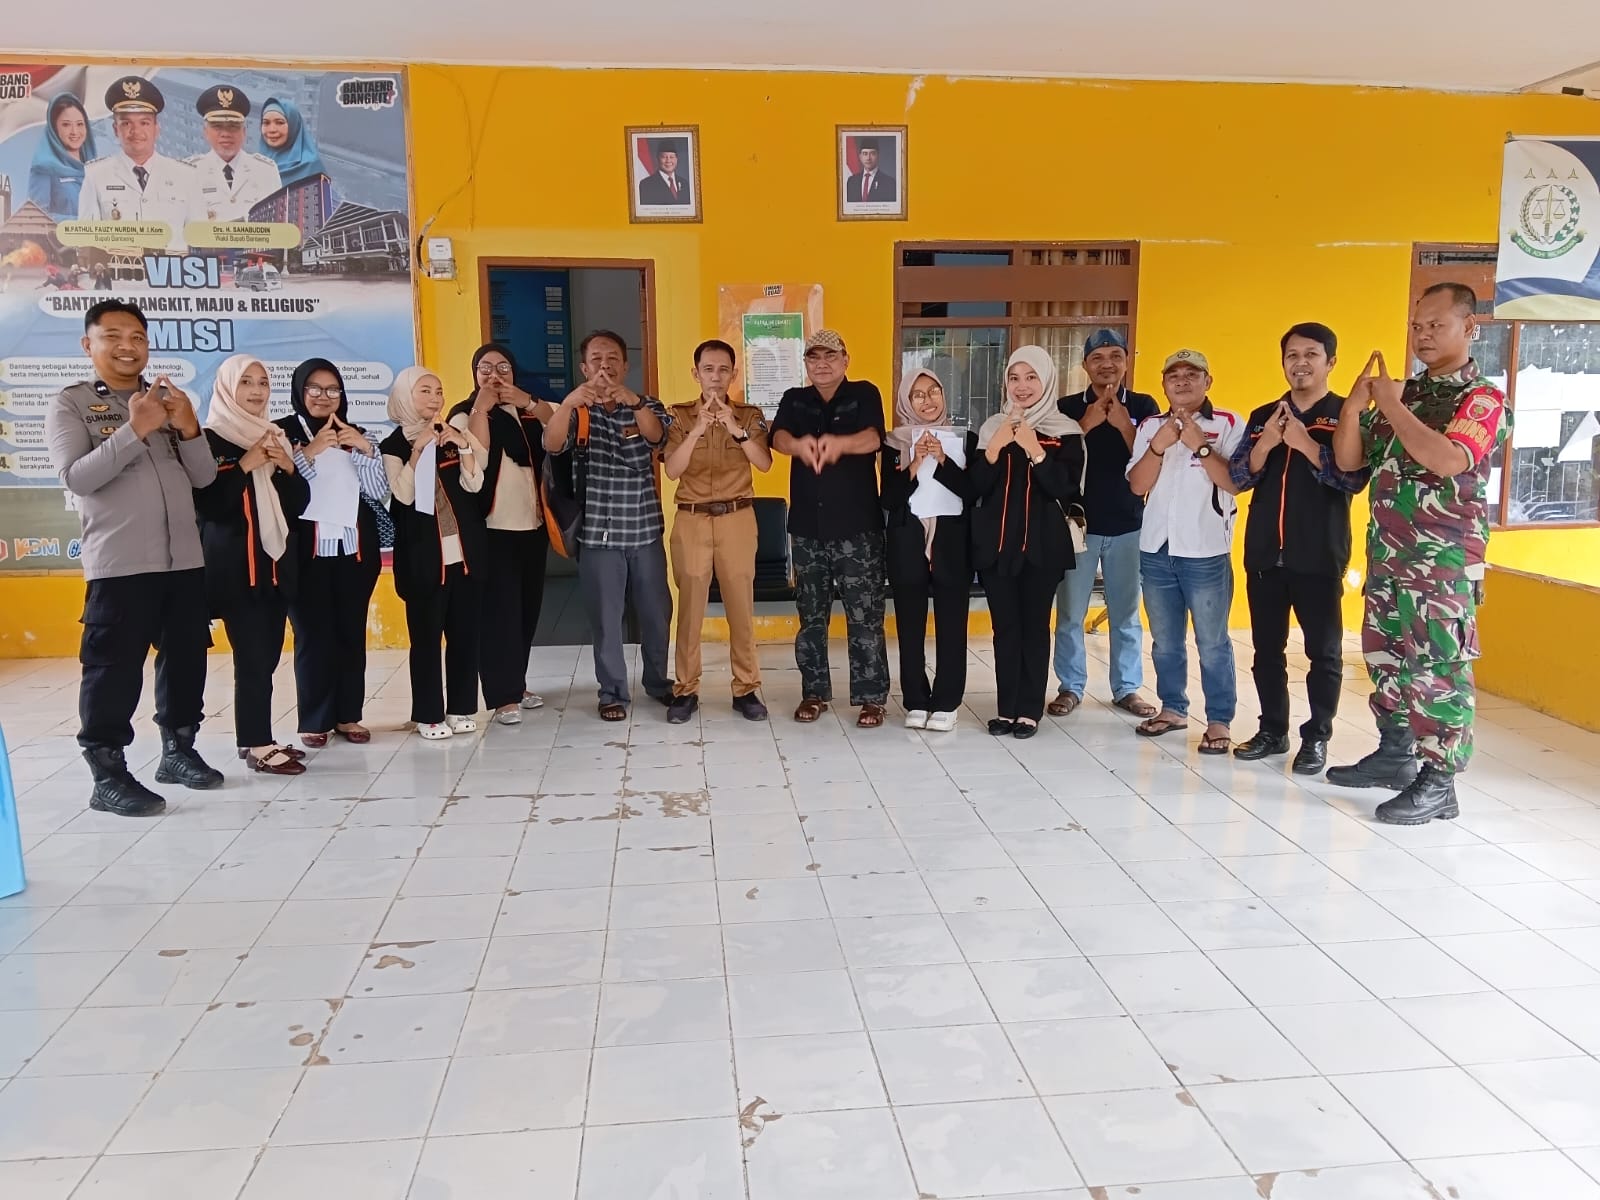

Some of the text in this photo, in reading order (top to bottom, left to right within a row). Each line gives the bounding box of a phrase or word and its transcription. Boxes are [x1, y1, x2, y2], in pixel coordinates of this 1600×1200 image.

[342, 80, 394, 93] BANTAENG
[94, 225, 113, 233] FAUZY
[232, 225, 271, 234] SAHABUDDIN
[144, 256, 220, 289] VISI
[196, 297, 234, 313] MAJU
[238, 300, 248, 313] &
[148, 318, 235, 352] MISI
[9, 363, 40, 371] Bantaeng
[42, 363, 67, 371] sebagai
[341, 366, 367, 374] dengan
[28, 371, 58, 380] menjamin
[12, 392, 42, 400] Bantaeng
[85, 413, 123, 424] SUHARDI
[14, 421, 45, 429] Bantaeng
[19, 455, 50, 463] Bantaeng
[19, 463, 55, 471] kerakyatan
